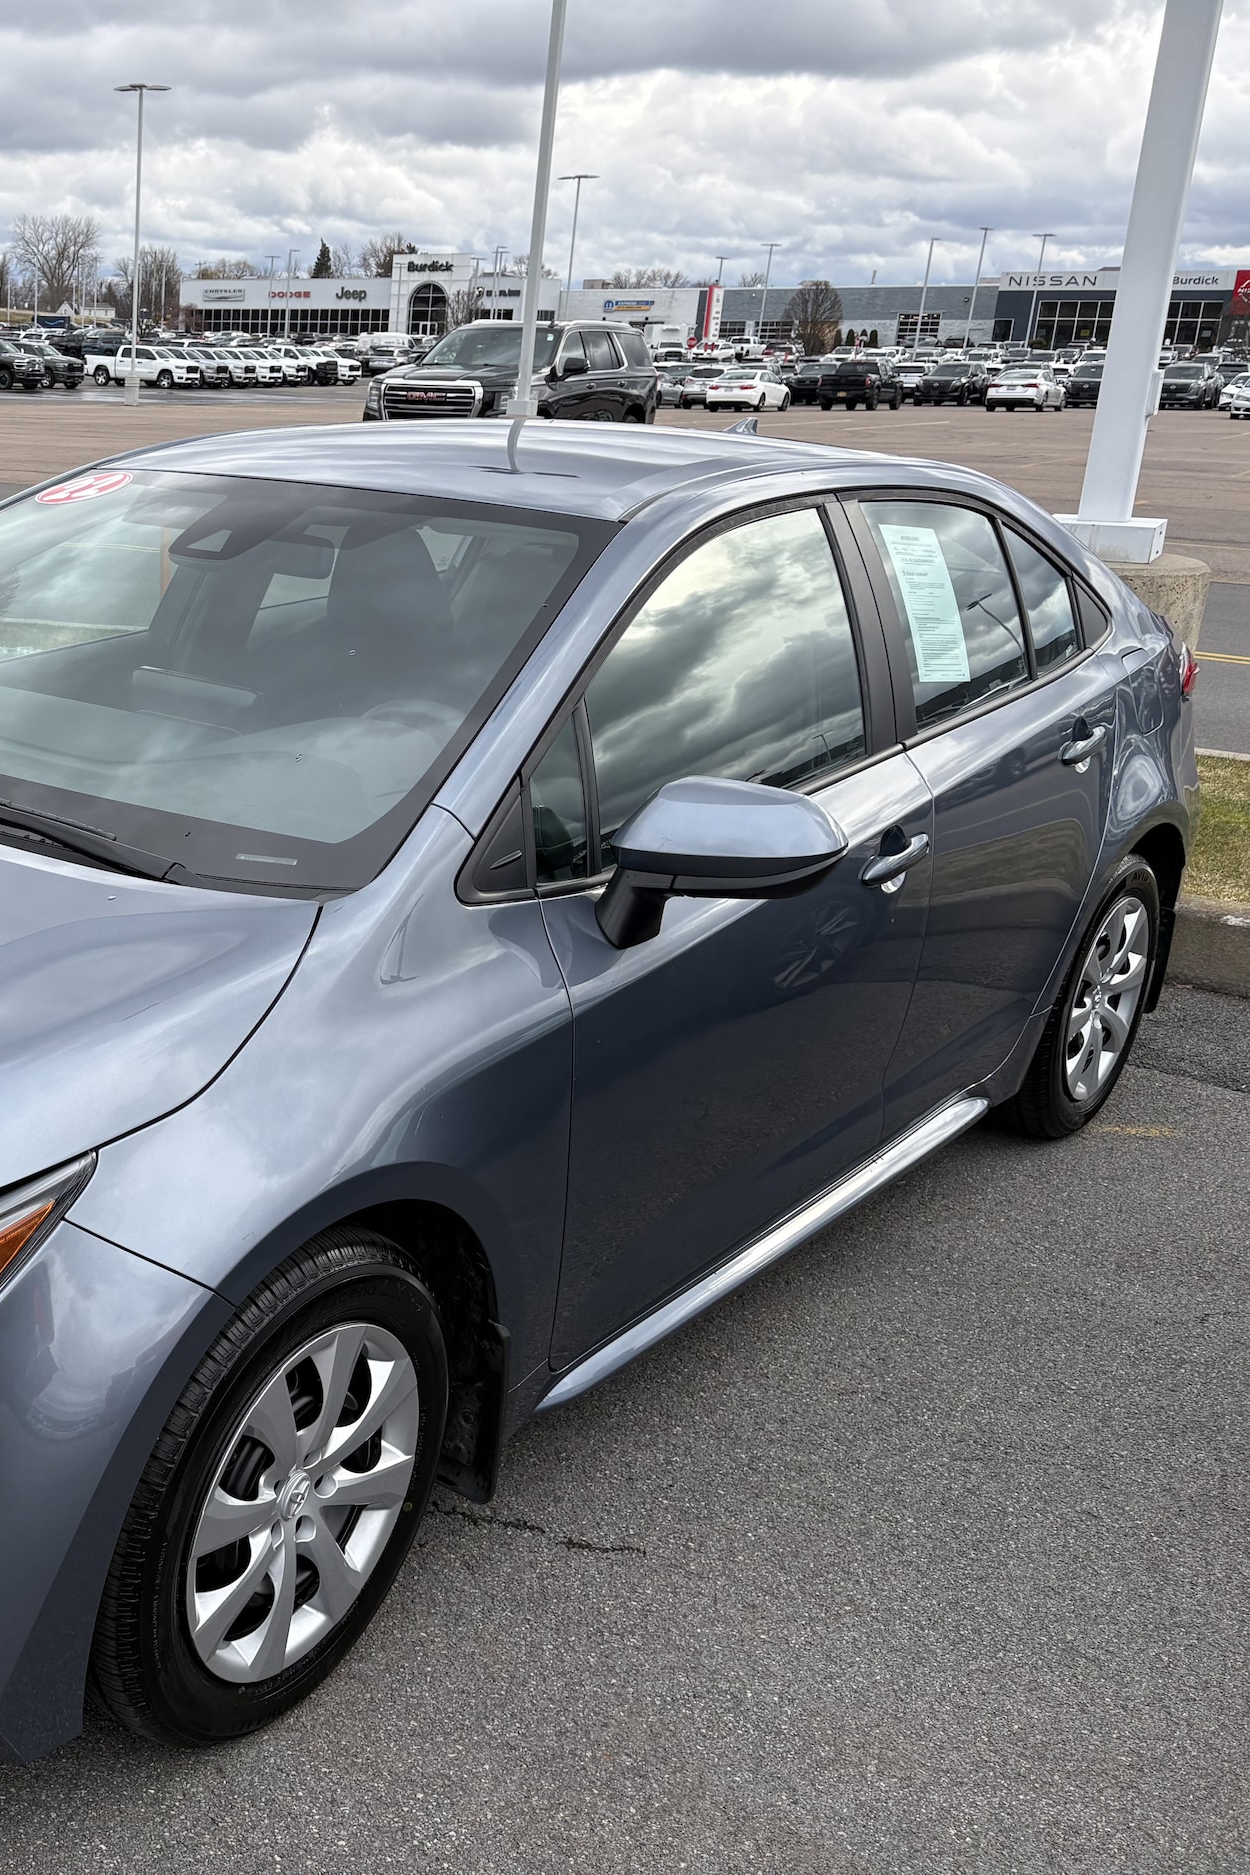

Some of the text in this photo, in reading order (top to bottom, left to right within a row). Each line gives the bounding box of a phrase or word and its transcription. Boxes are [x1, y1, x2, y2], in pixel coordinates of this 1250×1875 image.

[407, 260, 454, 272] Burdick
[1008, 275, 1098, 287] NISSAN
[1173, 275, 1219, 285] Burdick
[335, 286, 367, 302] Jeep
[406, 391, 446, 401] GMC
